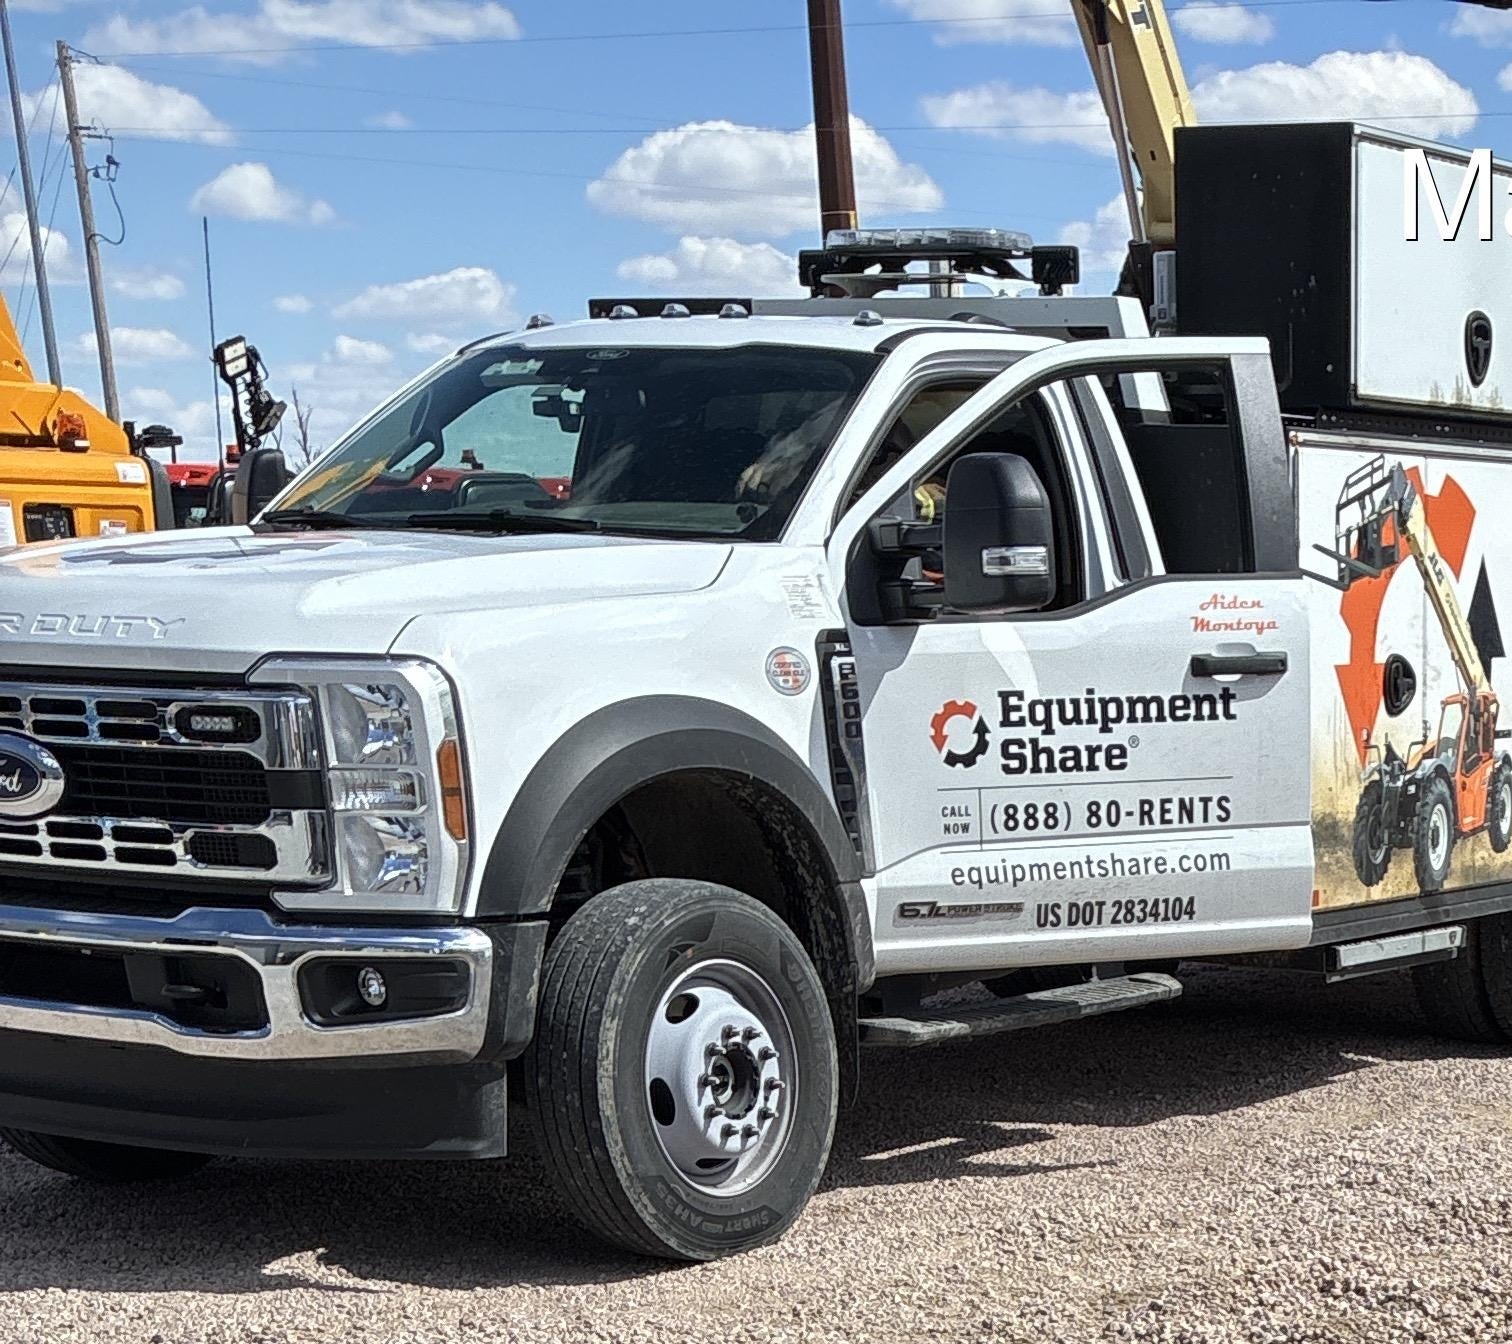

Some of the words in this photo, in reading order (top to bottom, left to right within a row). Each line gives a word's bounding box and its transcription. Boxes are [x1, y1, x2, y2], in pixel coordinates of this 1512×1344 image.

[30, 613, 186, 640] DUTY
[1190, 616, 1280, 635] Montoya
[997, 686, 1238, 736] Equipment
[941, 805, 972, 818] CALL
[990, 801, 1072, 834] (888)
[1086, 795, 1232, 829] 80-RENTS
[943, 822, 971, 835] NOW
[950, 852, 1231, 889] equipmentshare.com
[1036, 902, 1062, 928] US
[1067, 900, 1105, 927] DOT
[1110, 895, 1196, 926] 2834104
